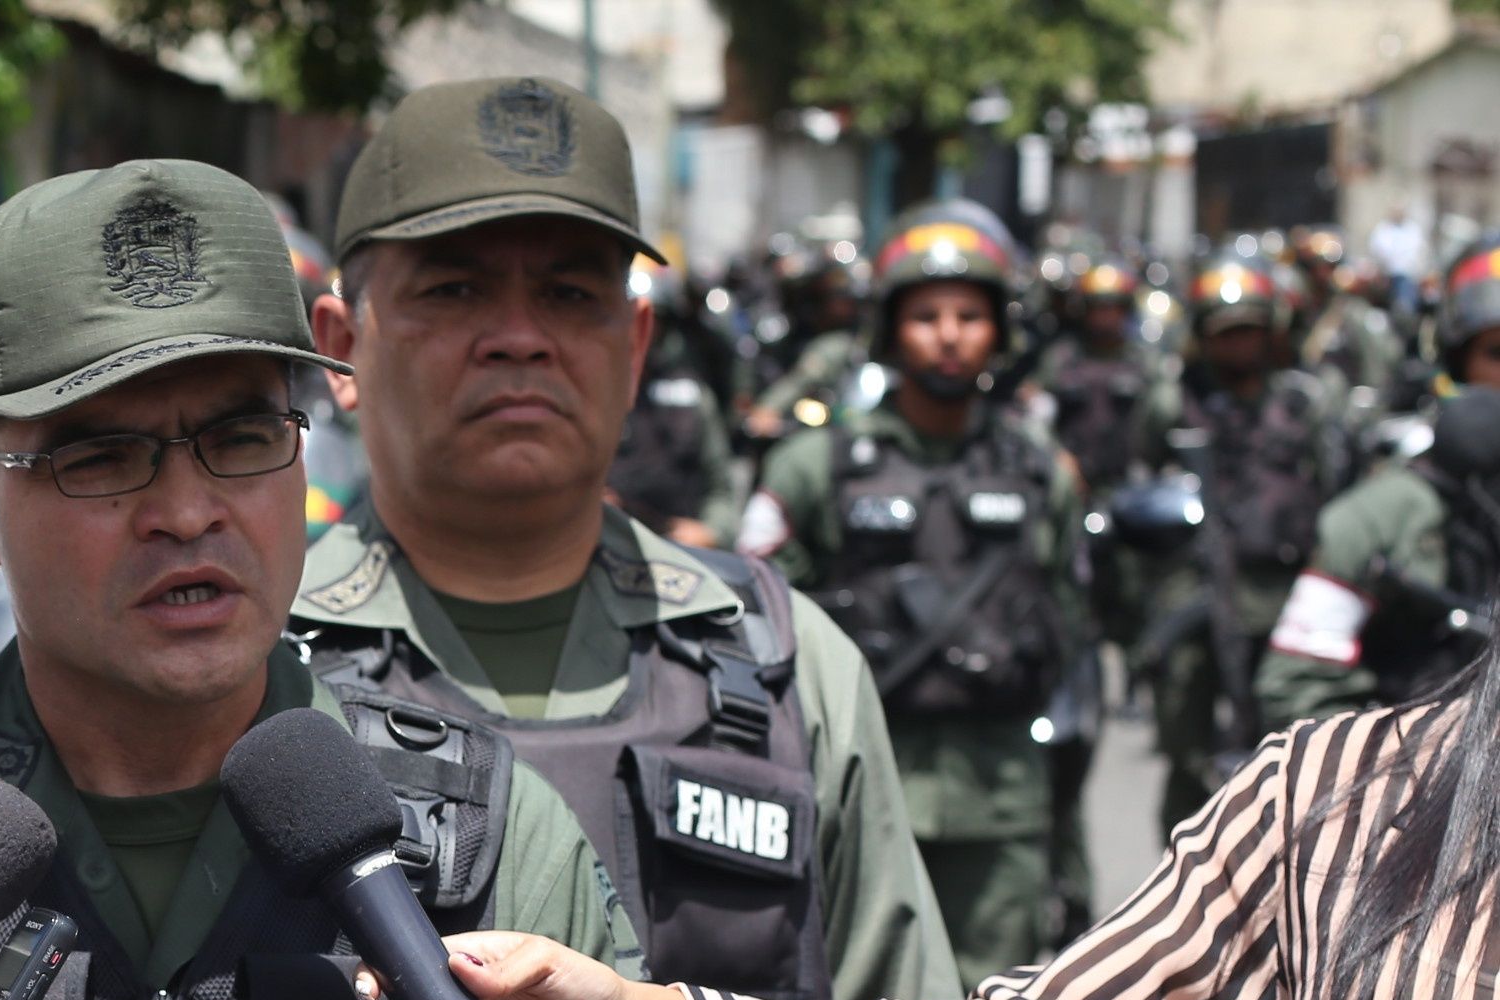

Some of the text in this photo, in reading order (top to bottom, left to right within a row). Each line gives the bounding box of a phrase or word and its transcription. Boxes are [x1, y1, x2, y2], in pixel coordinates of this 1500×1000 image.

[676, 779, 790, 860] FANB
[25, 920, 44, 931] SONY
[26, 978, 36, 990] VOL
